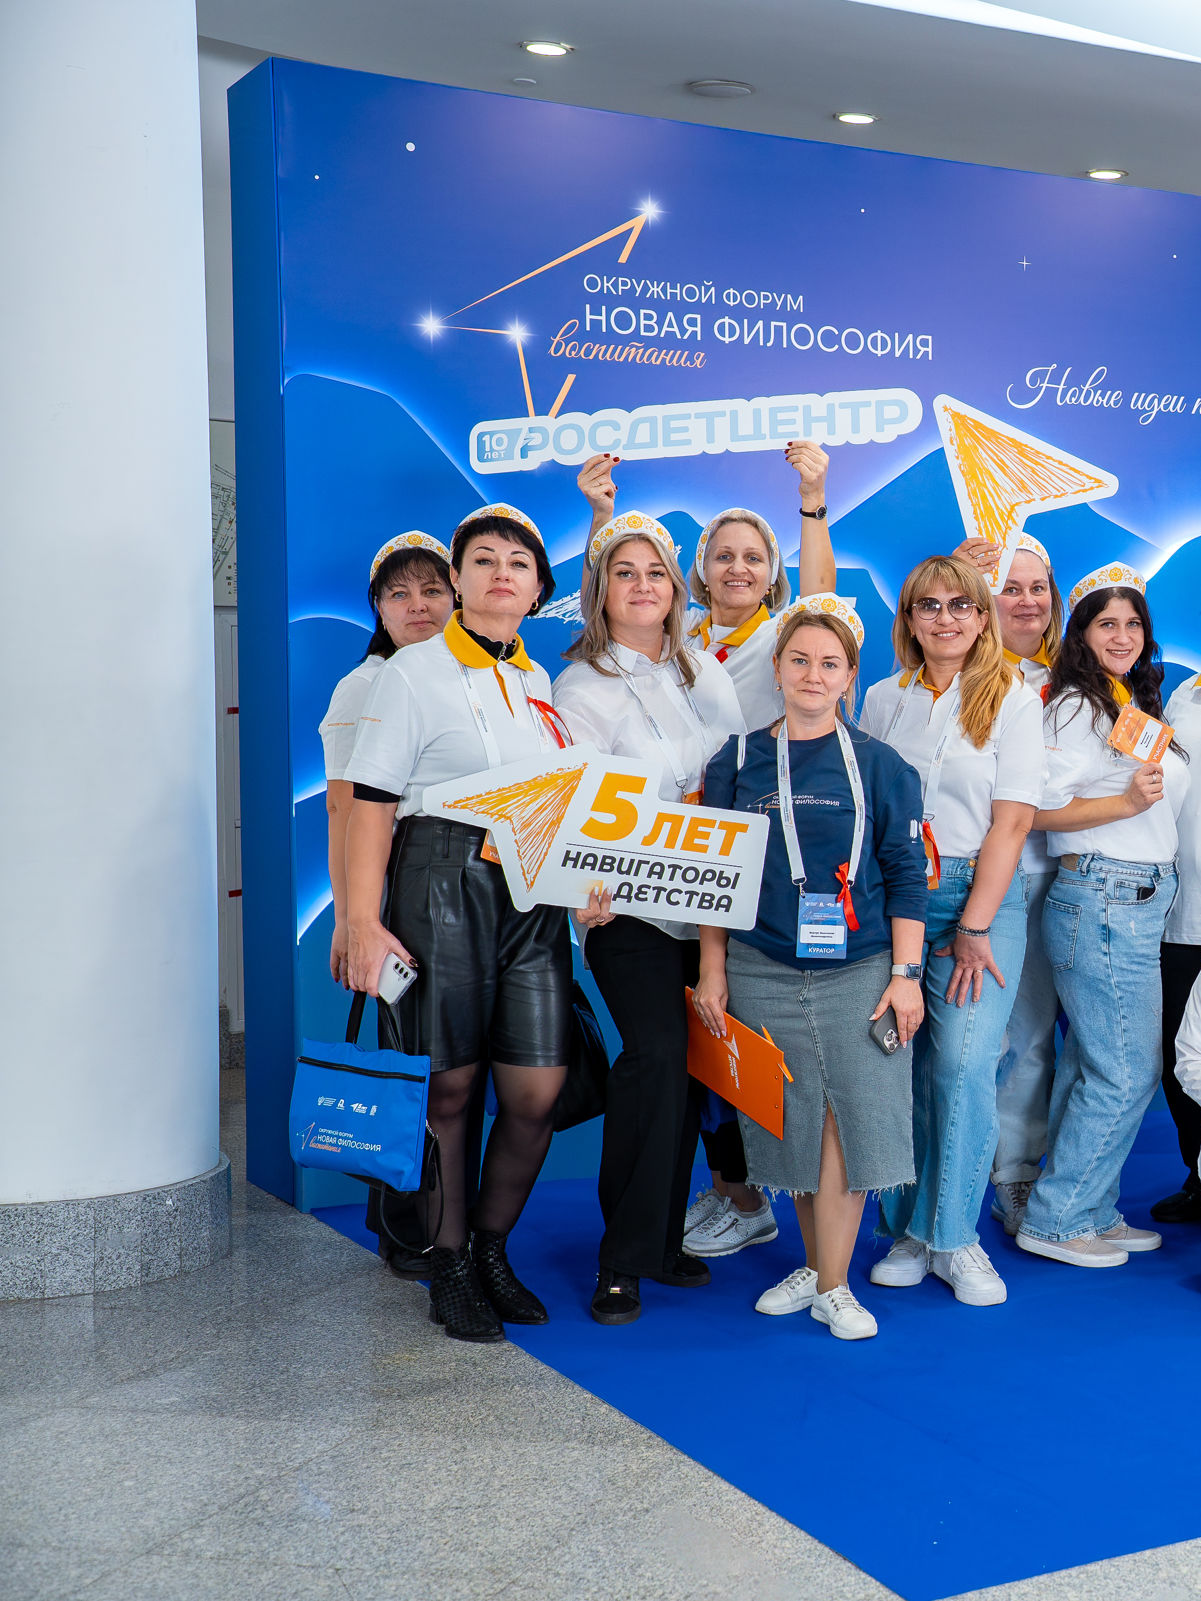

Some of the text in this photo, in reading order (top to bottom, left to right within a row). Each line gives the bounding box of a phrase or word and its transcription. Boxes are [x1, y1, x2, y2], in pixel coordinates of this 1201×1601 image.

[583, 273, 804, 313] ОКРУЖНОЙ ФОРУМ
[547, 319, 706, 370] воспитания
[585, 303, 934, 361] НОВАЯ ФИЛОСОФИЯ
[1006, 363, 1123, 409] Новые
[1130, 393, 1186, 426] идеи
[482, 433, 508, 452] 10
[520, 397, 910, 460] РОСДЕТЦЕНТР
[484, 451, 505, 460] лет
[579, 771, 749, 857] 5 ЛЕТ
[794, 798, 840, 806] ФИЛОСОФИЯ
[561, 849, 741, 890] НАВИГАТОРЫ
[612, 881, 733, 913] ДЕТСТВА
[317, 1134, 382, 1152] НОВАЯ ФИЛОСОФИЯ
